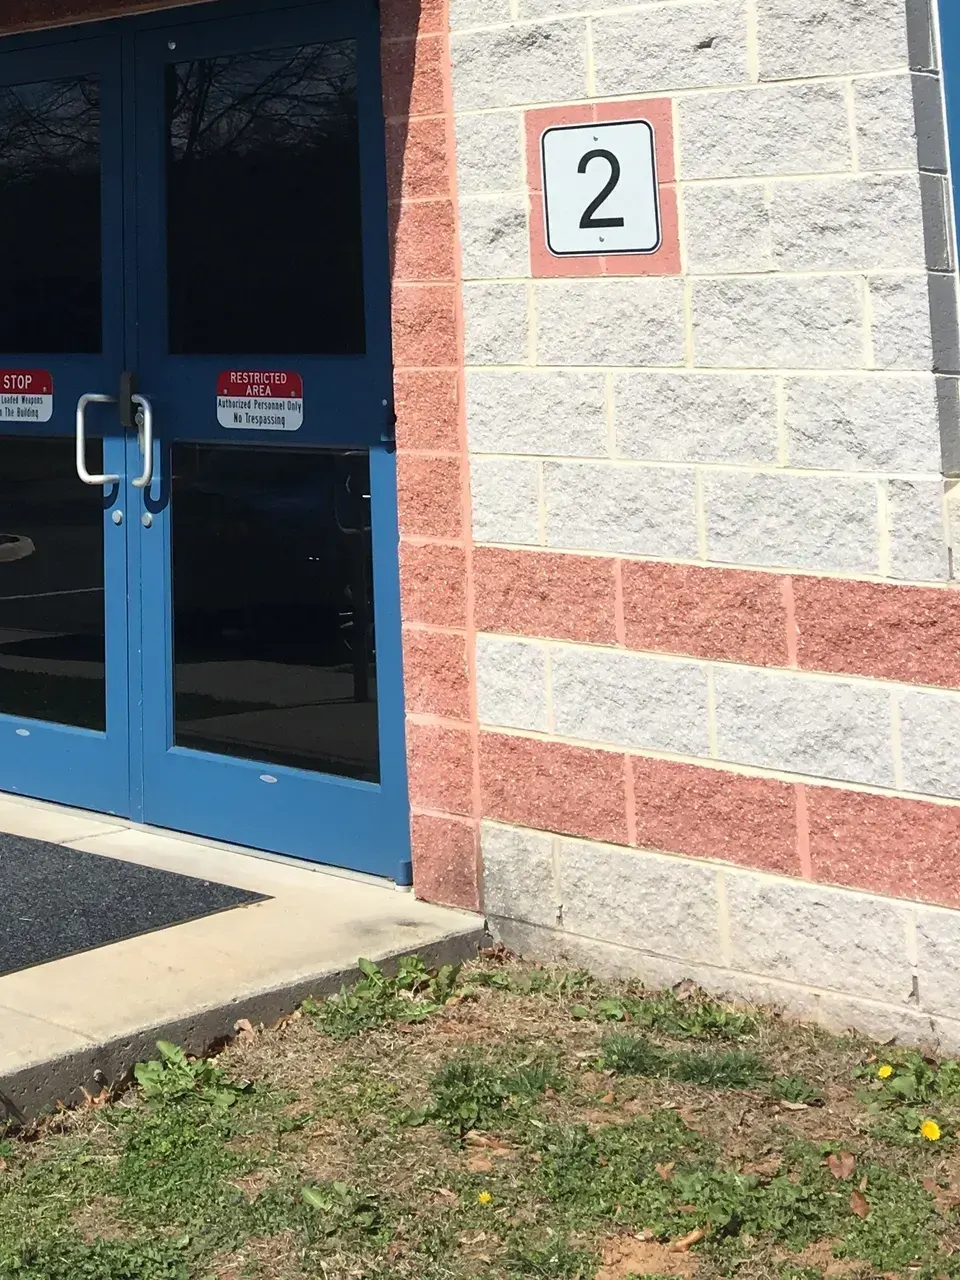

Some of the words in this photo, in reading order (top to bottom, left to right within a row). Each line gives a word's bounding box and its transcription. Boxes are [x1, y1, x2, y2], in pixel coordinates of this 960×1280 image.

[577, 149, 624, 229] 2
[3, 374, 32, 389] STOP
[230, 372, 287, 384] RESTRICTED
[245, 384, 272, 396] AREA
[1, 395, 19, 405] Loaded
[21, 395, 43, 406] Weapons
[218, 398, 251, 409] Authorized
[253, 399, 285, 411] Personnel
[287, 400, 302, 414] Only
[5, 407, 14, 417] The
[16, 407, 39, 420] Building
[233, 412, 242, 423] No
[245, 412, 286, 428] Trespassing
